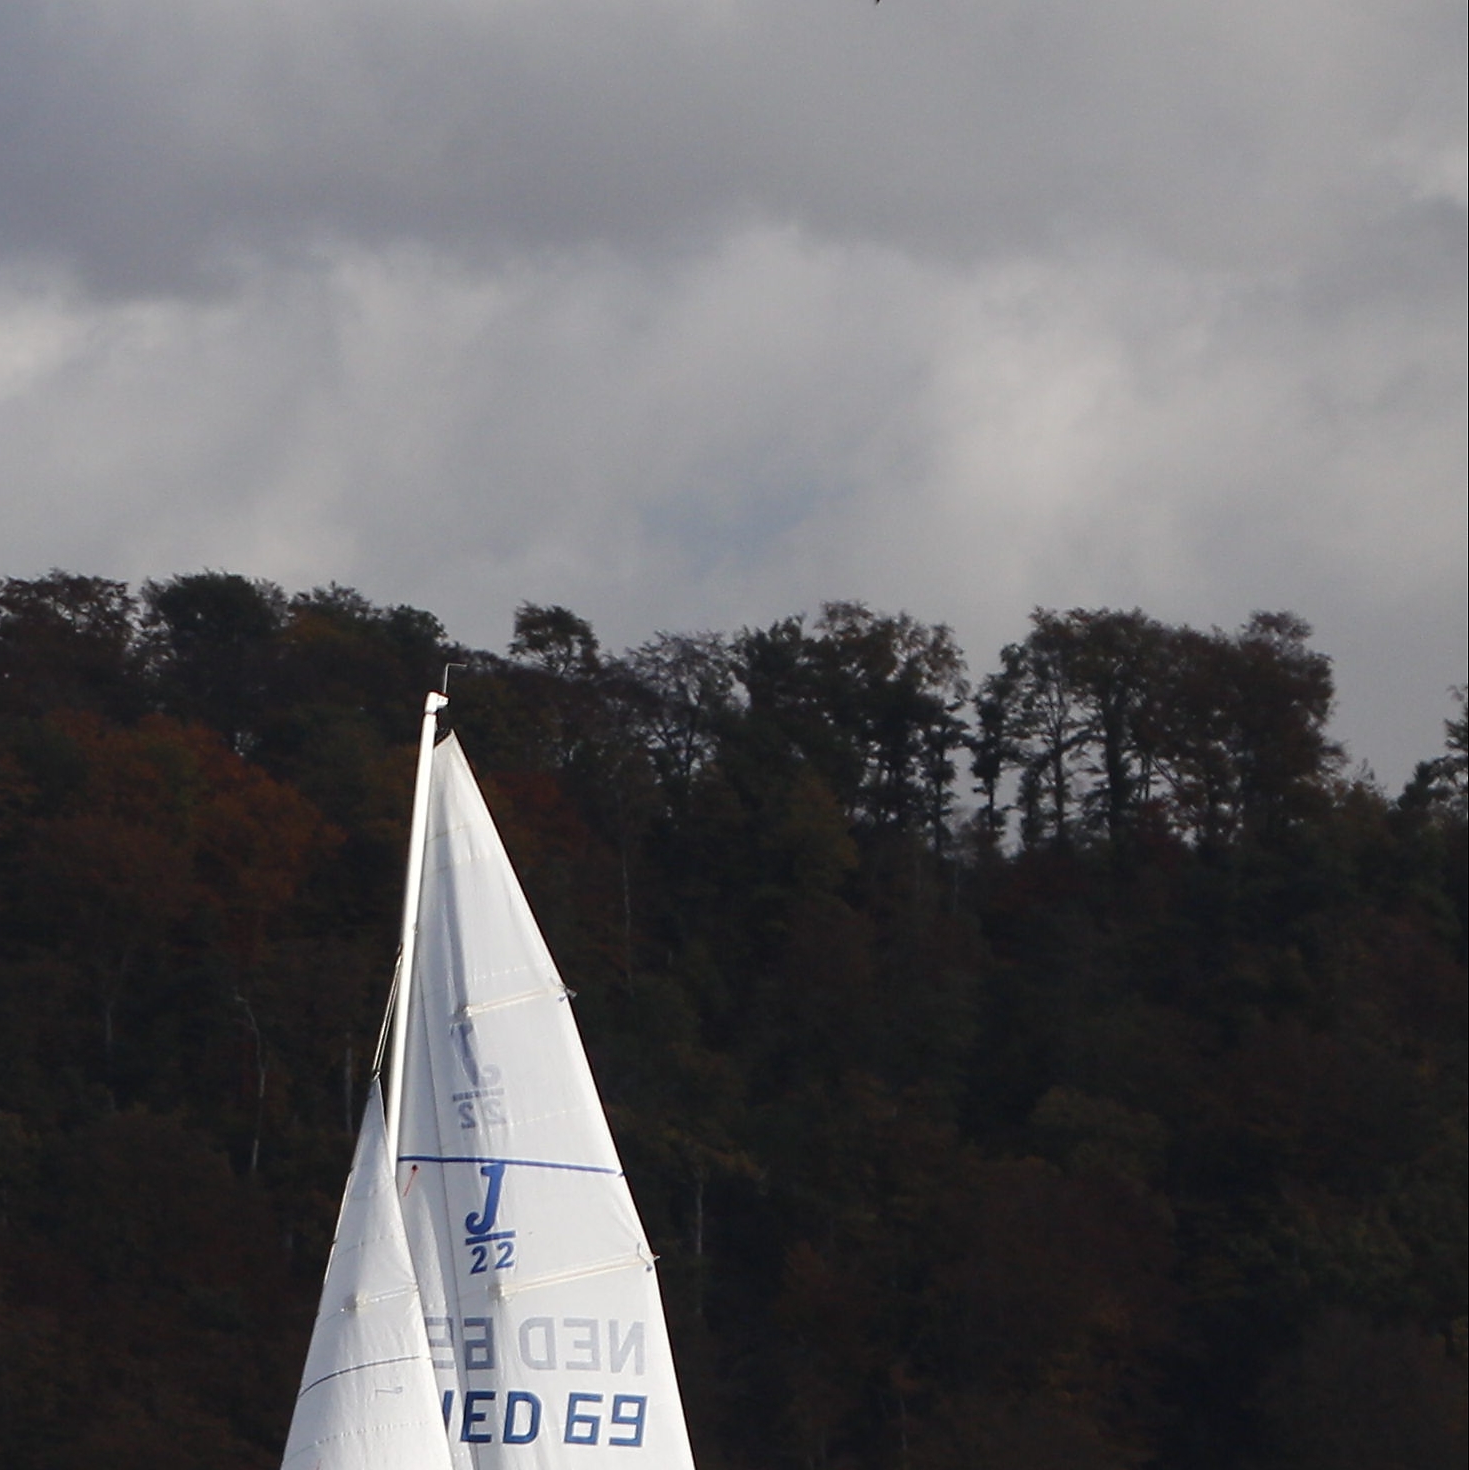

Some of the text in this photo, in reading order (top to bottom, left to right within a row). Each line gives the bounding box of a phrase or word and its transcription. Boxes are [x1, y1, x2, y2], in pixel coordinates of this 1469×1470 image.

[465, 1162, 506, 1235] J
[470, 1241, 515, 1275] 22
[563, 1392, 648, 1447] 69
